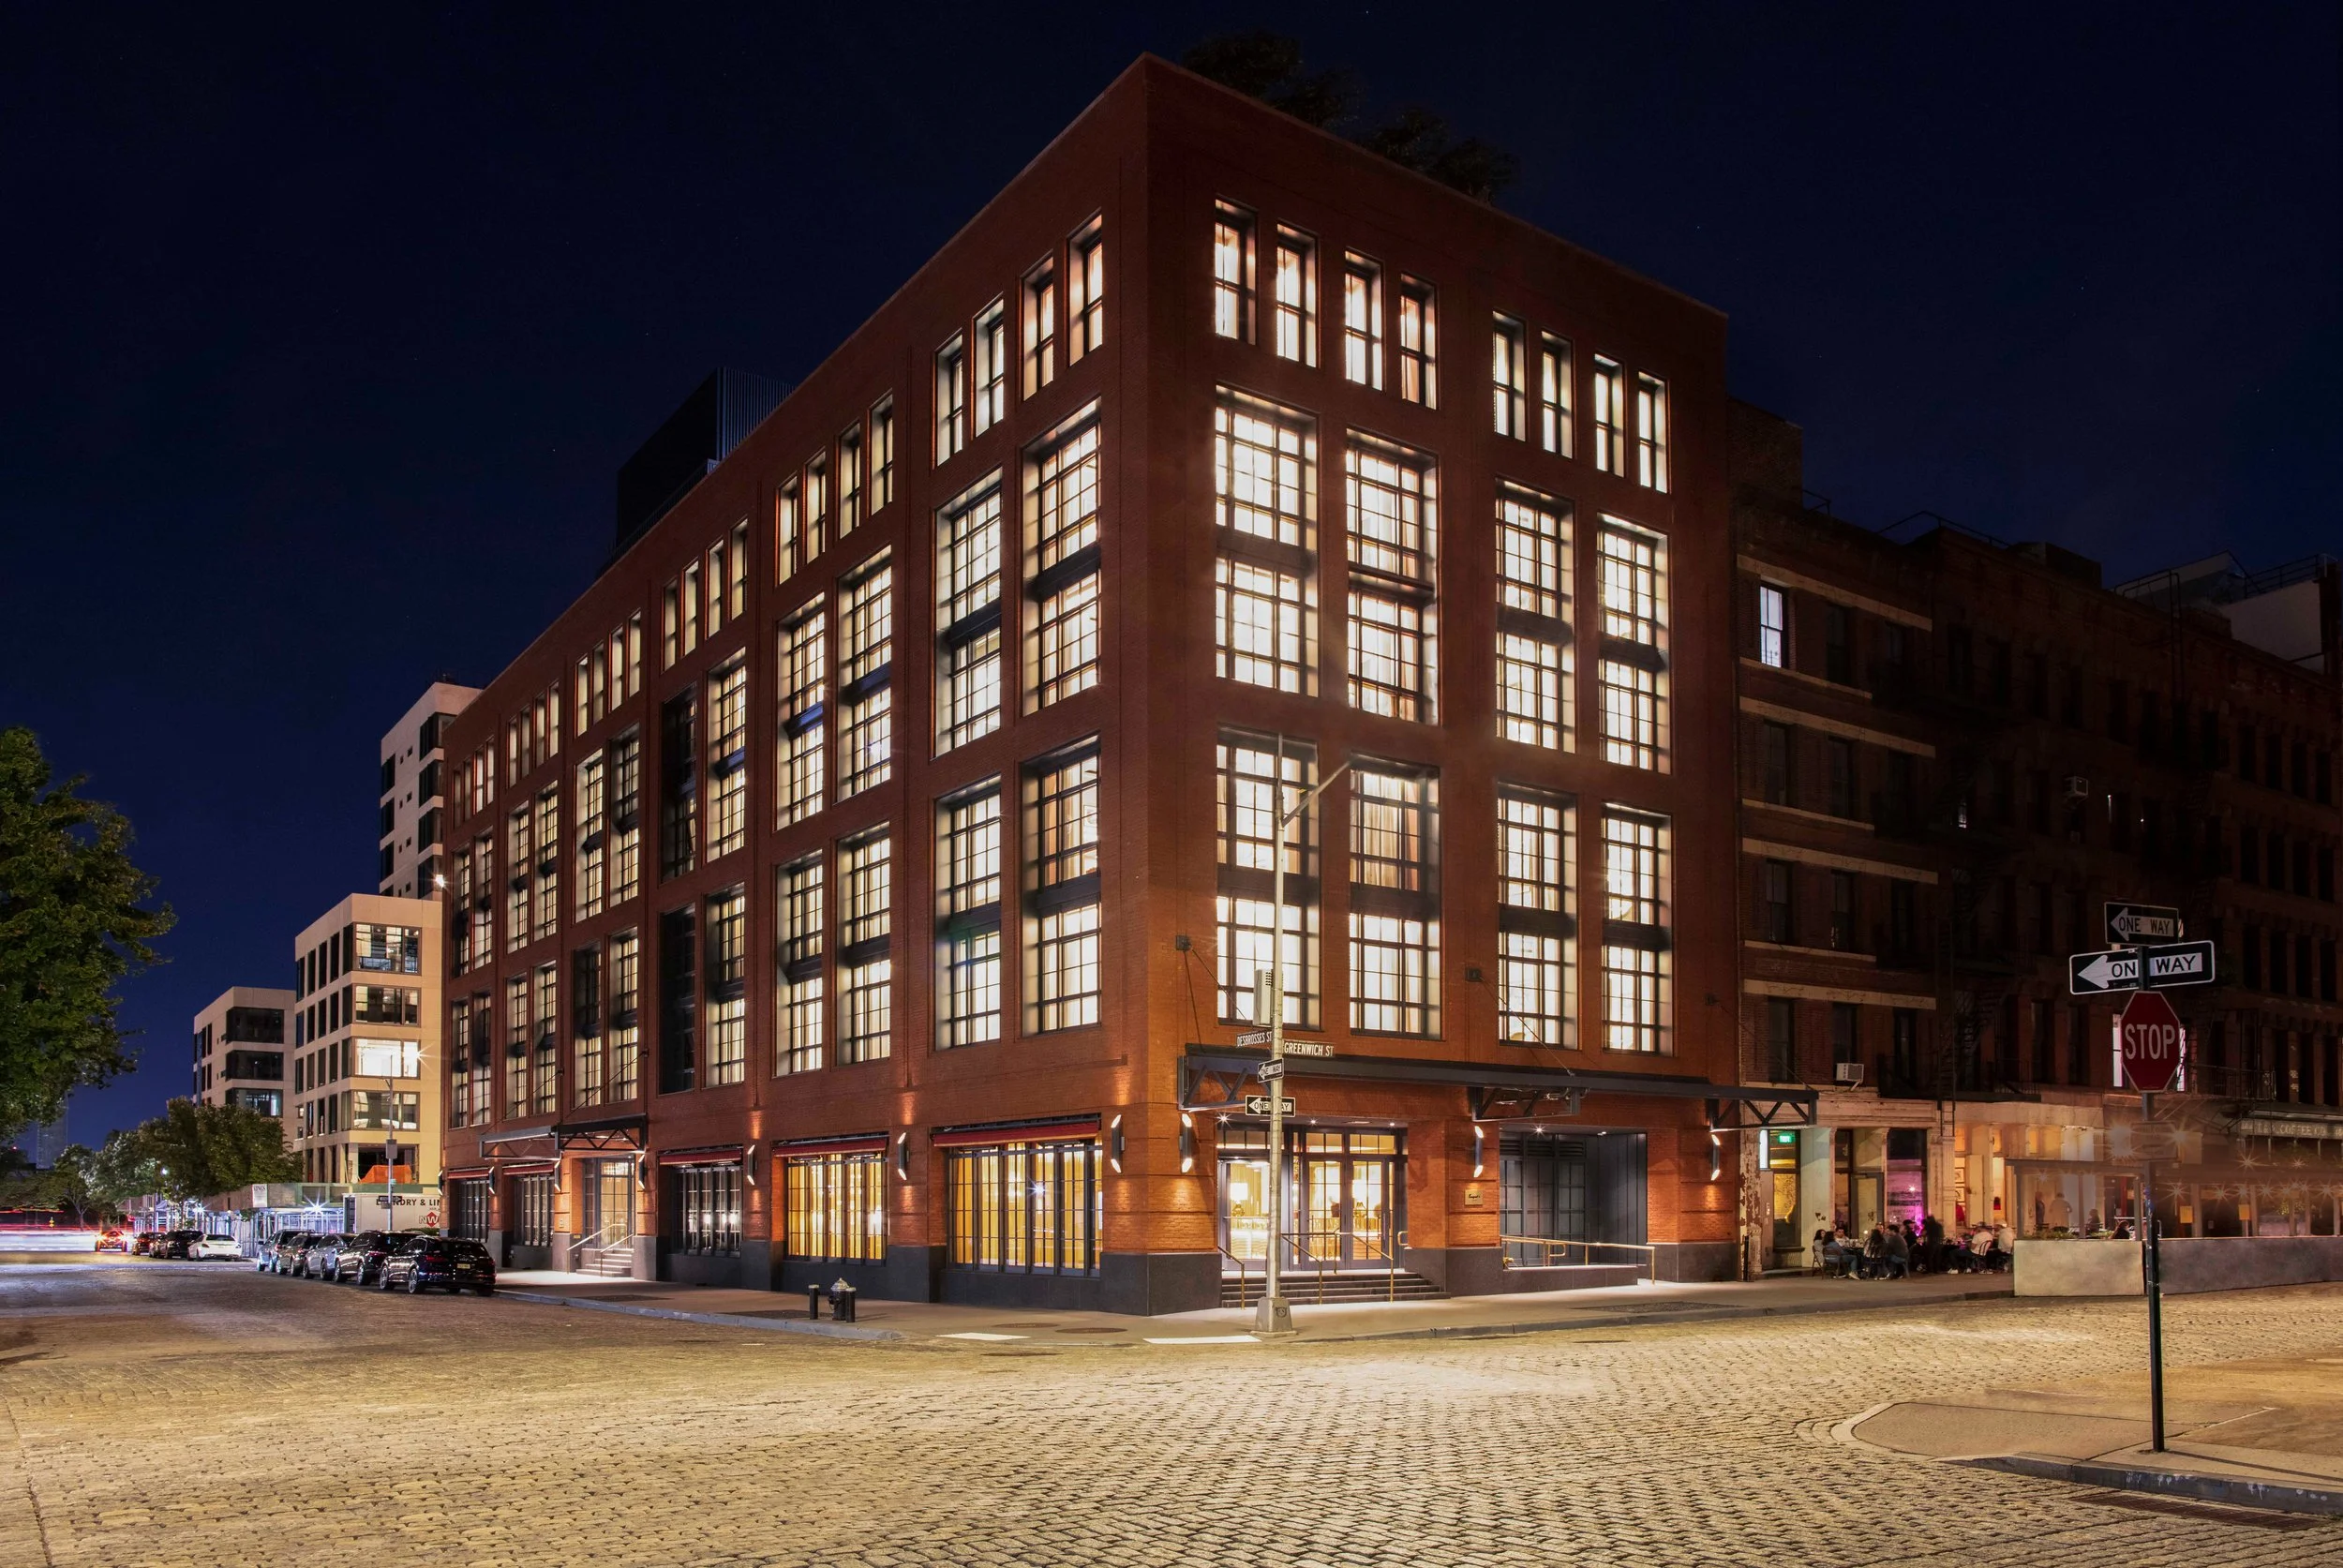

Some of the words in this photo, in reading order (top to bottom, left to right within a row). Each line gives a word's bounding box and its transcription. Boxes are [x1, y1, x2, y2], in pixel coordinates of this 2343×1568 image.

[2118, 917, 2142, 933] ONE
[2150, 919, 2171, 934] WAY
[2112, 962, 2136, 978] ON
[2156, 955, 2196, 974] WAY
[1237, 1032, 1265, 1047] DESBROSSES
[1266, 1031, 1273, 1042] ST
[2125, 1023, 2176, 1060] STOP
[1284, 1042, 1323, 1056] GREENWICH
[1325, 1045, 1335, 1056] ST
[1261, 1068, 1269, 1076] ONE
[1254, 1101, 1268, 1110] ONE
